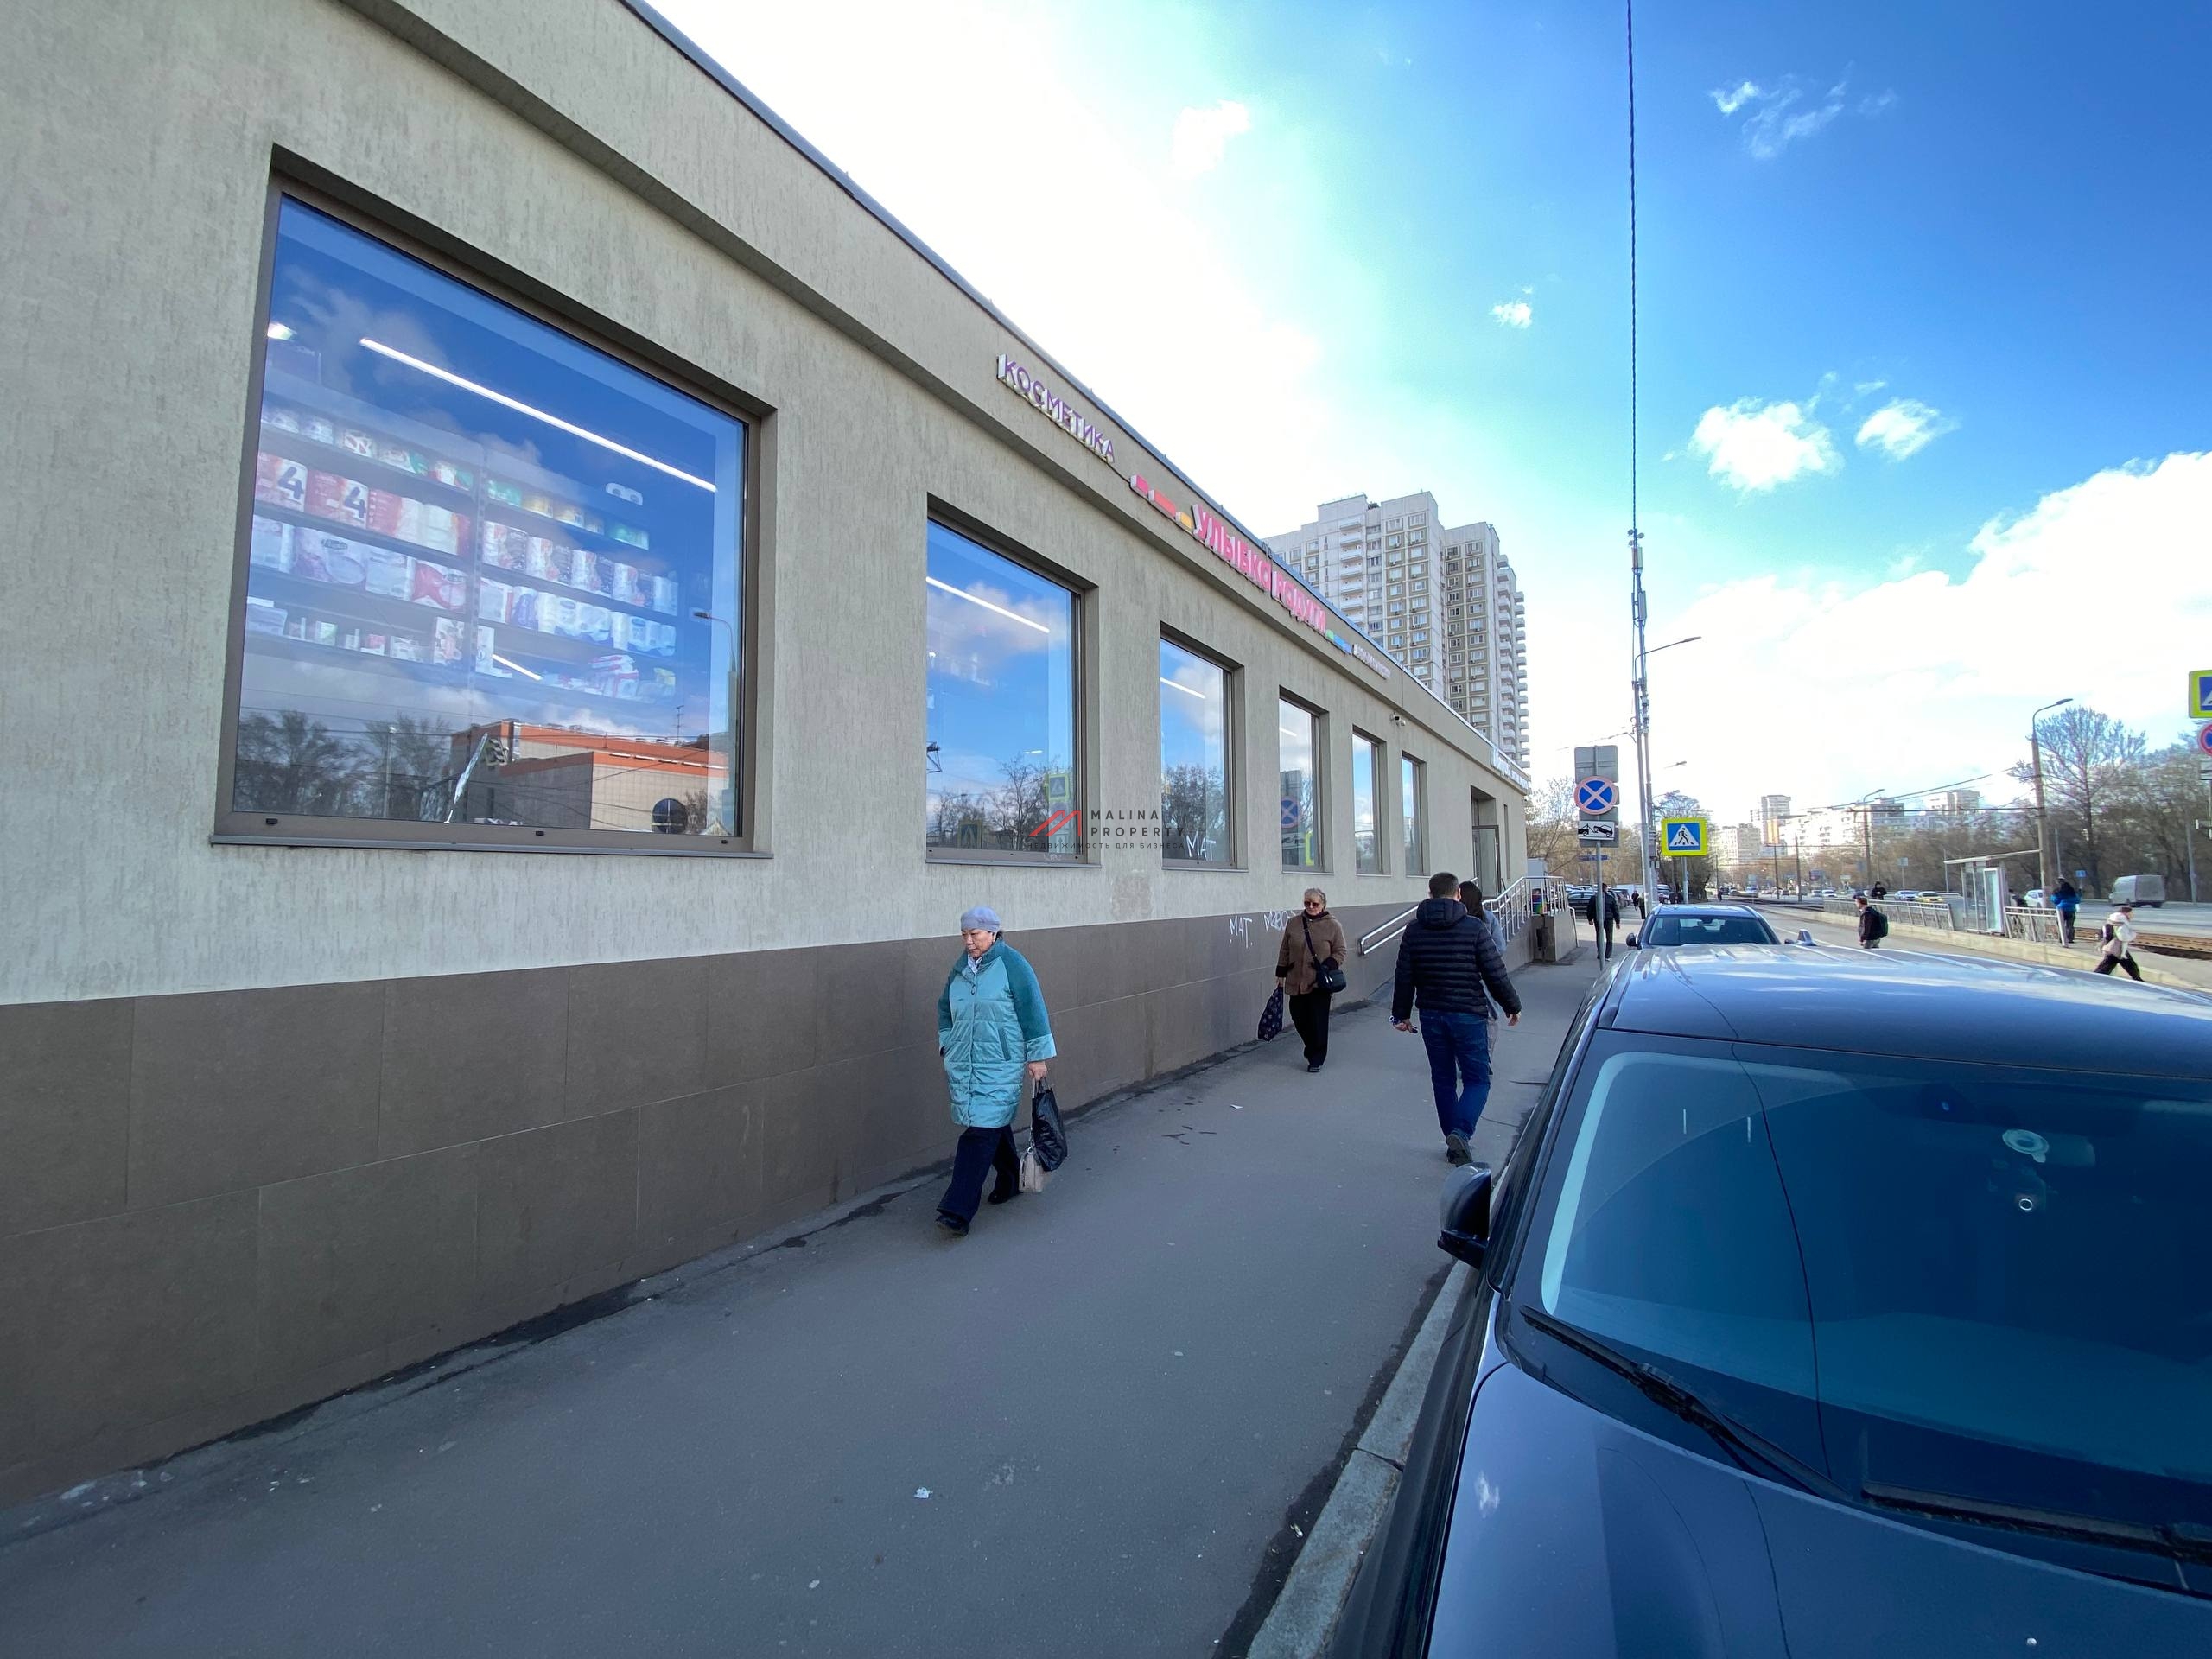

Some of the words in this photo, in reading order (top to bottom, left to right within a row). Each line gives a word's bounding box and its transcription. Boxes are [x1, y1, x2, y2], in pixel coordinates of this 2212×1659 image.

[997, 354, 1115, 464] КОСМЕТИКА
[278, 466, 304, 500] 4
[344, 486, 367, 519] 4
